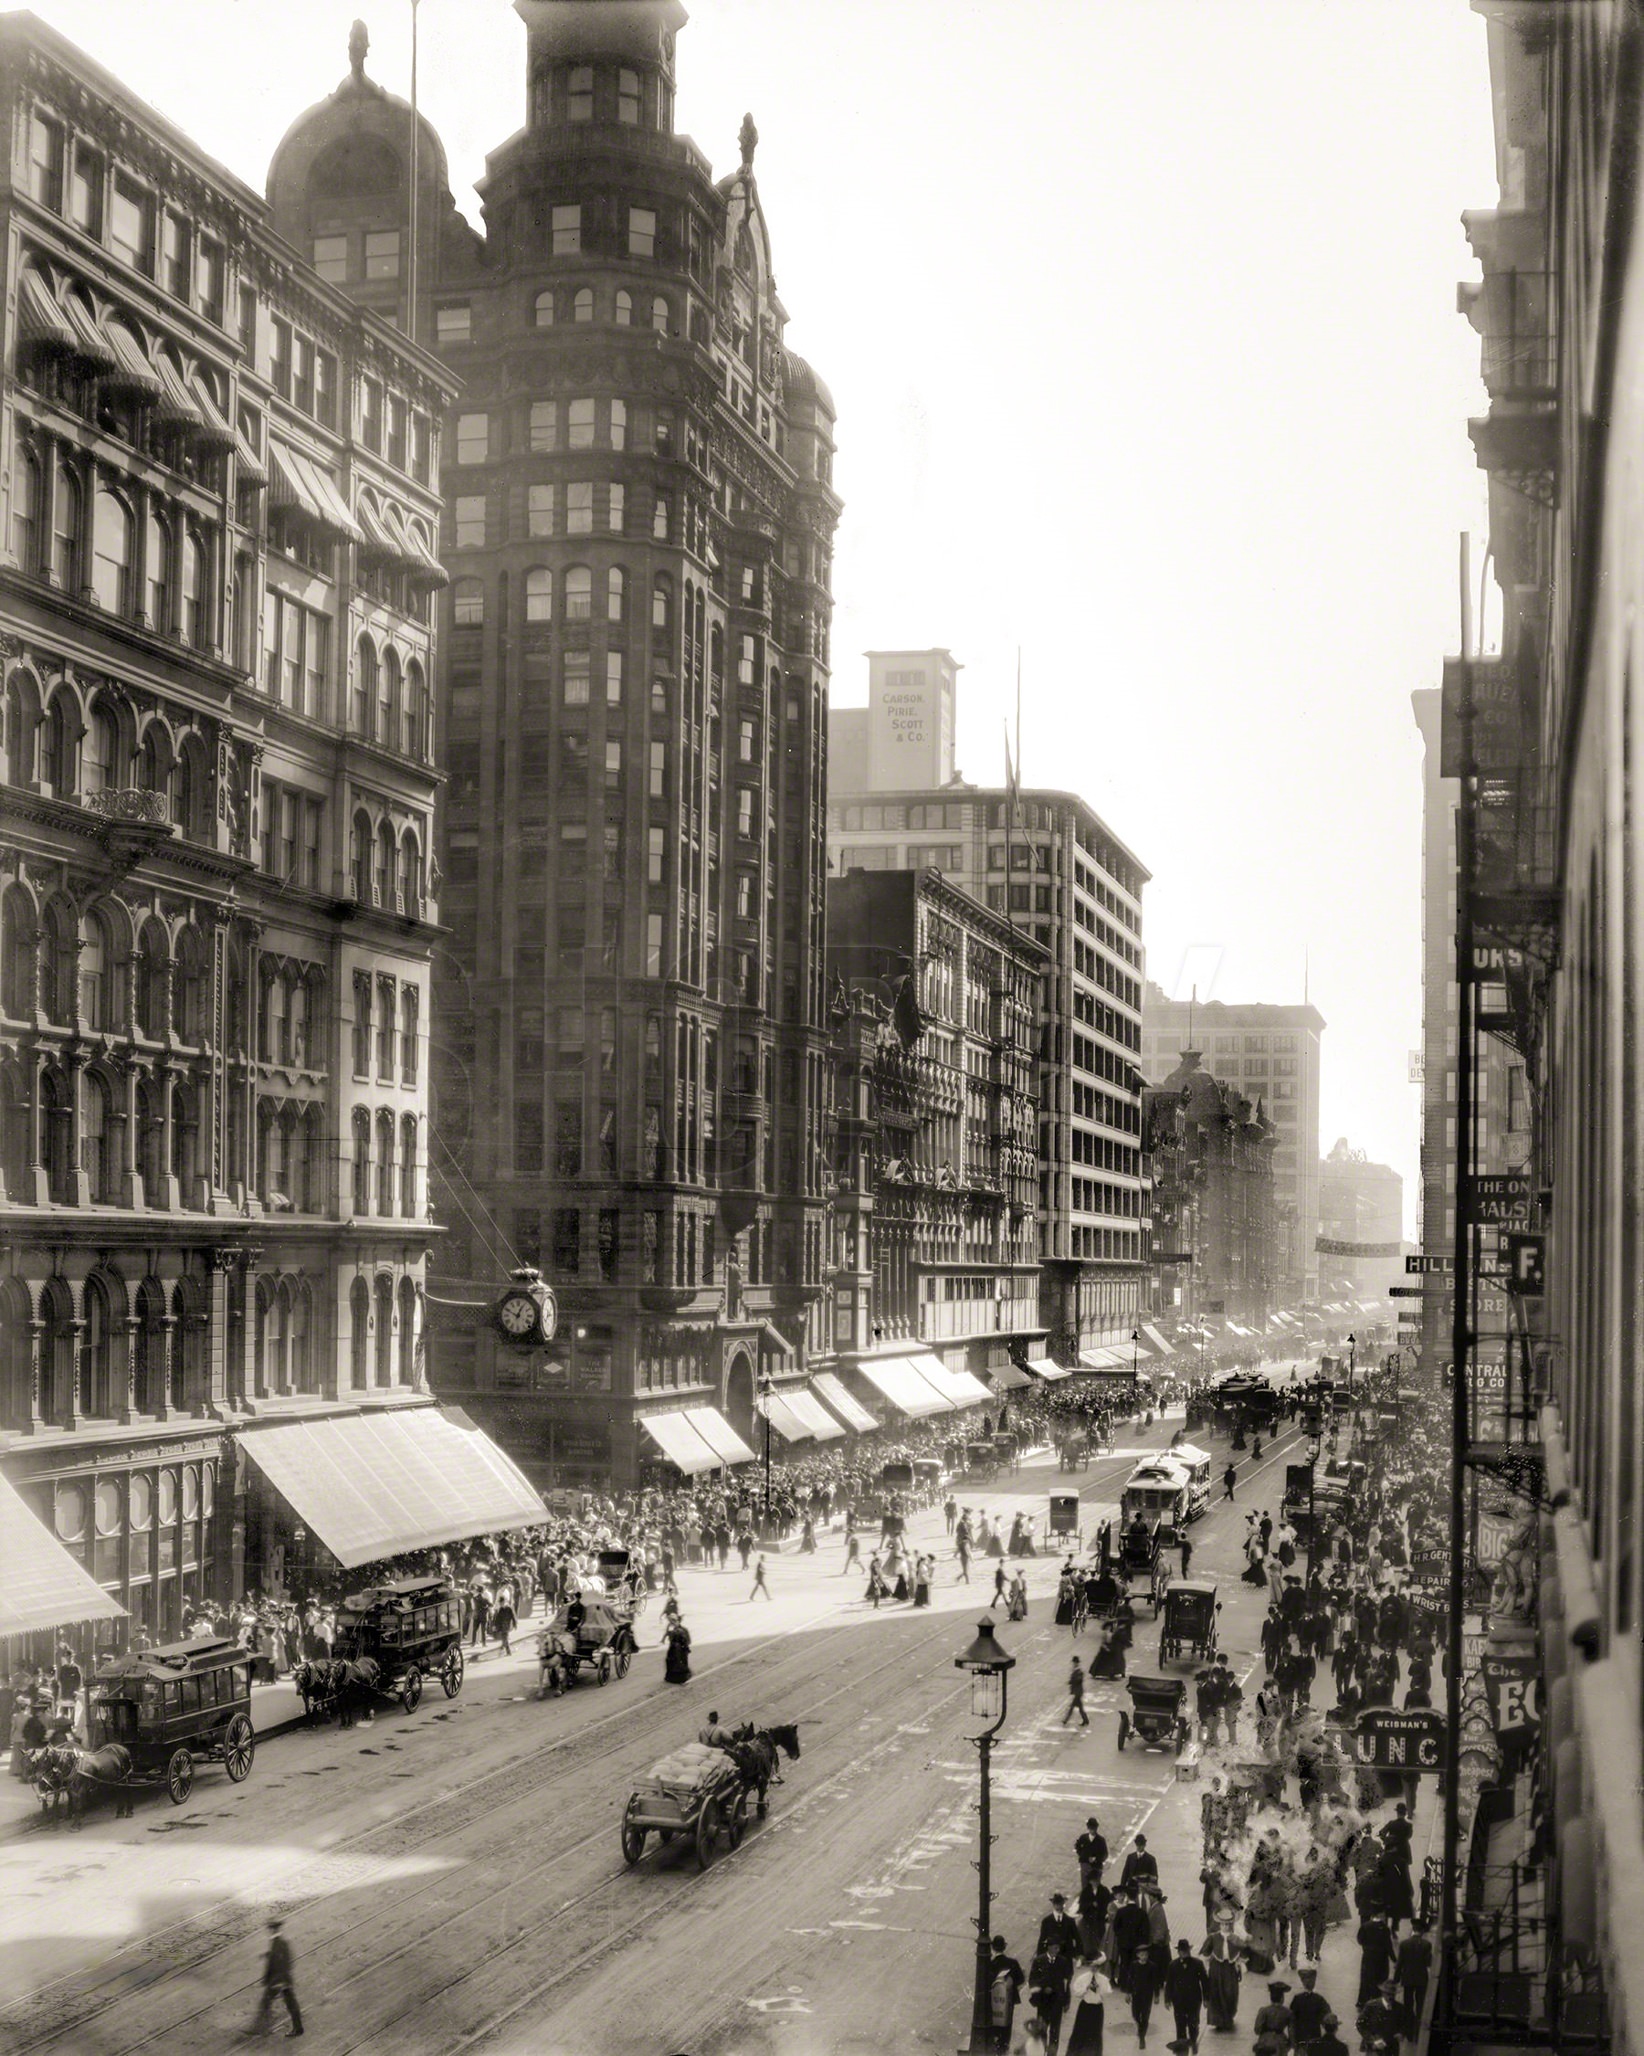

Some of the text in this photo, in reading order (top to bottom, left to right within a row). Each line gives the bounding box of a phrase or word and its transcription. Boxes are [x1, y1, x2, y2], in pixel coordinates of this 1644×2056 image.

[892, 718, 924, 730] SCOTT
[896, 733, 904, 742] &
[1478, 1181, 1504, 1193] THE
[1447, 1363, 1507, 1377] CNTRAL
[1490, 1378, 1505, 1388] CO
[1412, 1594, 1441, 1612] WRIST
[1487, 1662, 1522, 1677] The
